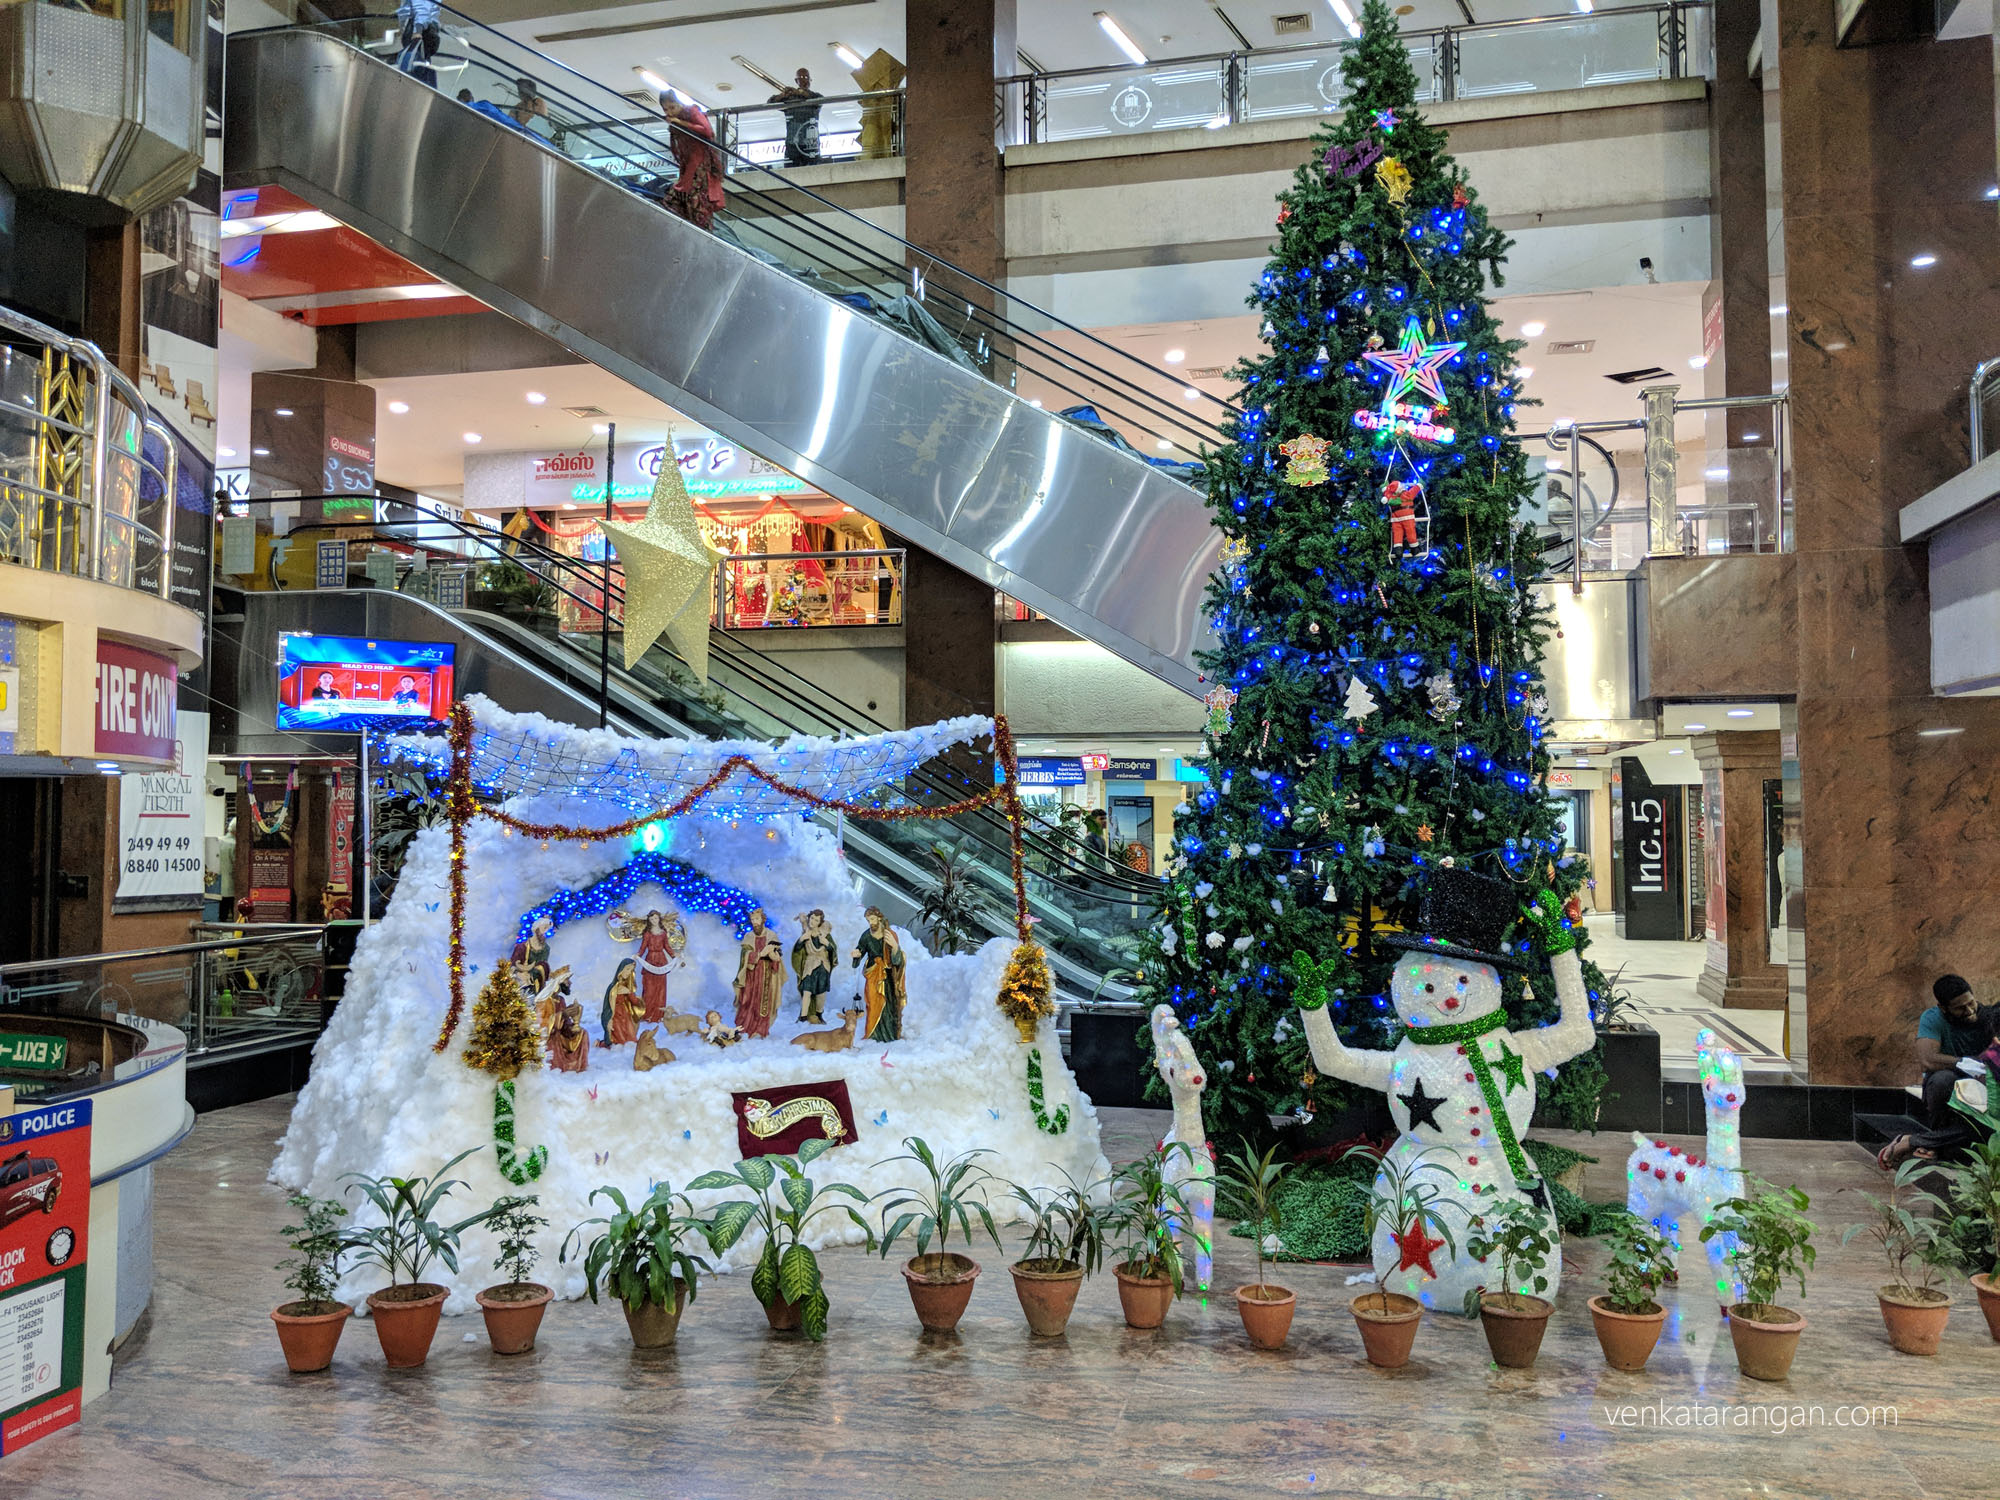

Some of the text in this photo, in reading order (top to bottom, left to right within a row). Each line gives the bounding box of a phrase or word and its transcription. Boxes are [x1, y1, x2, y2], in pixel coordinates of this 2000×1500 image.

[339, 440, 371, 460] NO SMOKING
[434, 503, 498, 532] Sri Khna
[176, 541, 200, 556] Premier
[171, 585, 201, 597] partments
[141, 776, 192, 795] MANGAL
[1020, 771, 1055, 783] HERBES
[144, 795, 184, 812] TIRTH
[157, 837, 171, 851] 49
[175, 837, 190, 851] 49
[1631, 798, 1662, 892] Inc.5
[125, 857, 200, 873] 8840 14500
[12, 1041, 48, 1063] EXIT
[784, 1099, 834, 1121] CHRISTMAS
[22, 1108, 76, 1135] POLICE
[21, 1184, 47, 1199] POLICE
[13, 1295, 45, 1314] THOUSAND
[46, 1288, 64, 1301] LIGHT
[23, 1341, 33, 1351] 100
